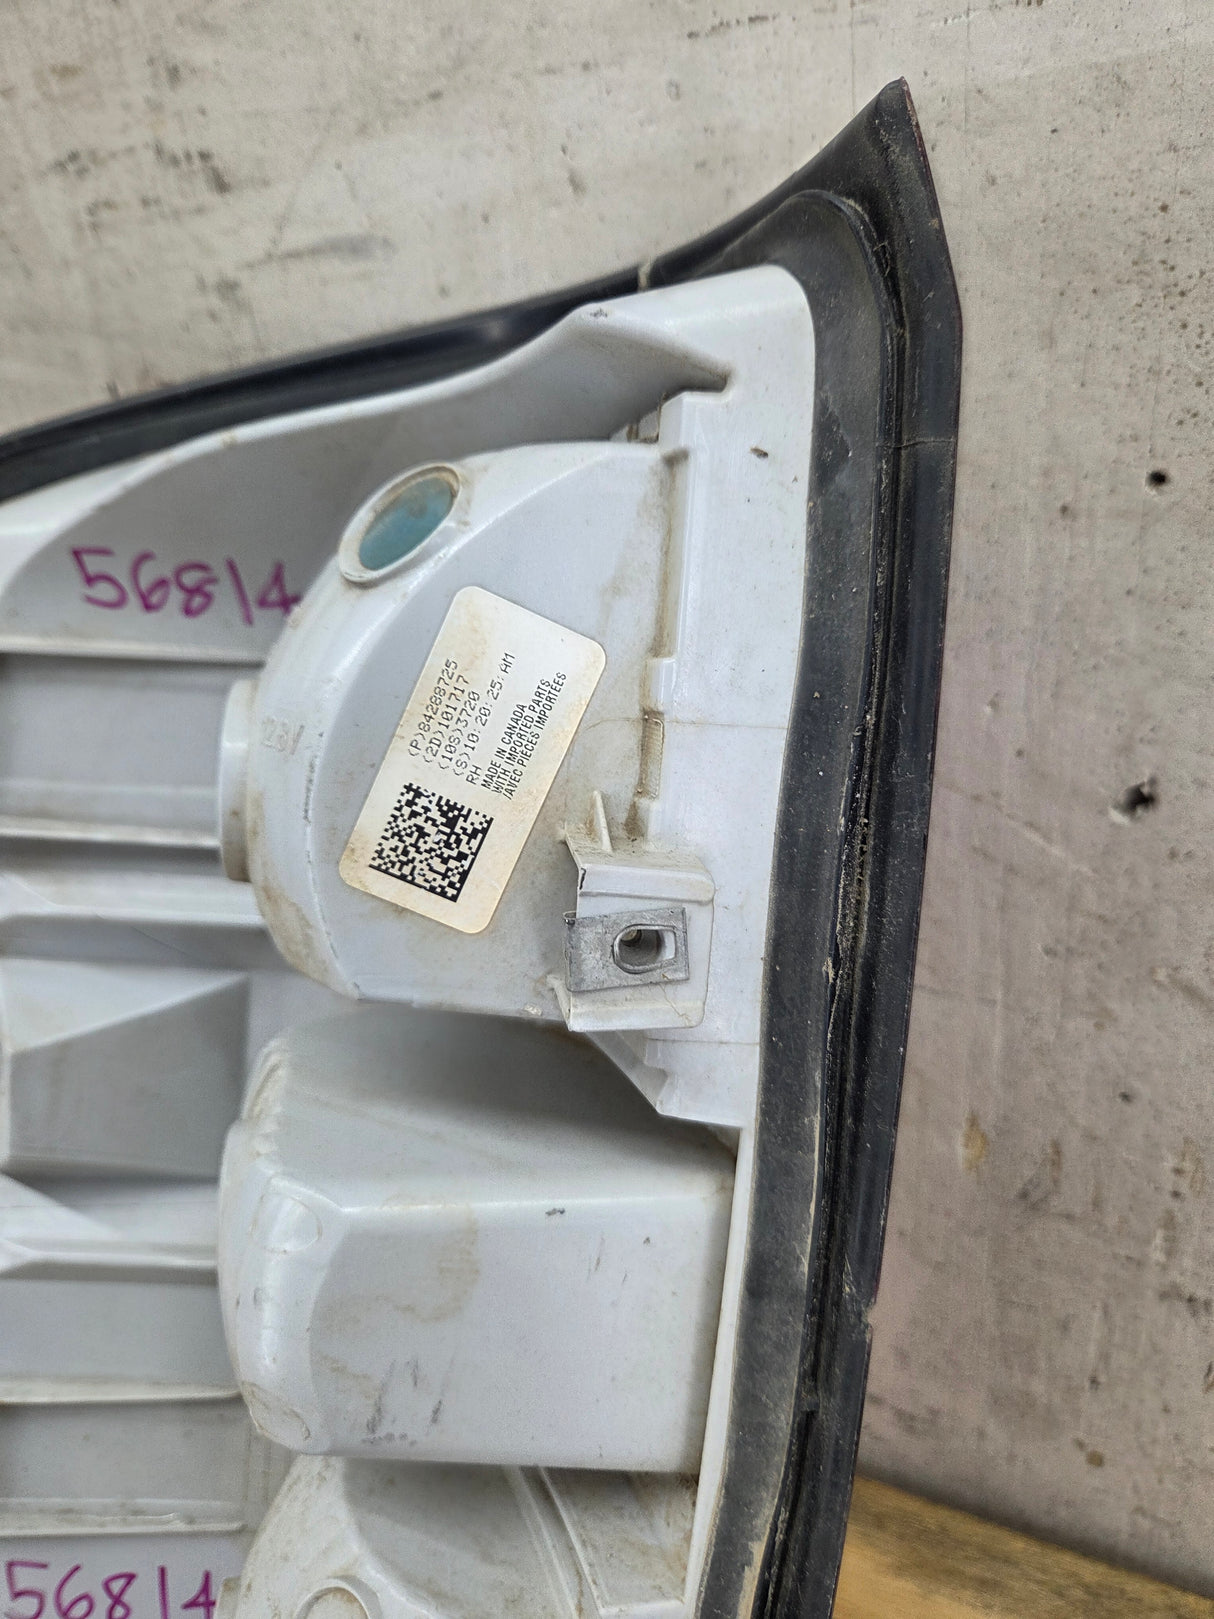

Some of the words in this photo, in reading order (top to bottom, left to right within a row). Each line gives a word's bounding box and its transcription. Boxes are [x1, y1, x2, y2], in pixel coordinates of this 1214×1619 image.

[71, 546, 301, 626] 56814
[408, 659, 457, 756] (P)84288725
[423, 675, 469, 763] (2D)101717
[438, 691, 480, 769] (10S)3720
[481, 760, 501, 789] MADE
[494, 747, 507, 759] IN
[501, 704, 527, 745] CANADA
[491, 768, 511, 793] WITH
[504, 715, 534, 766] IMPORTED
[528, 679, 550, 713] PARTS
[466, 765, 482, 785] RH
[503, 769, 523, 800] /AVEC
[5, 1560, 216, 1619] 56814
